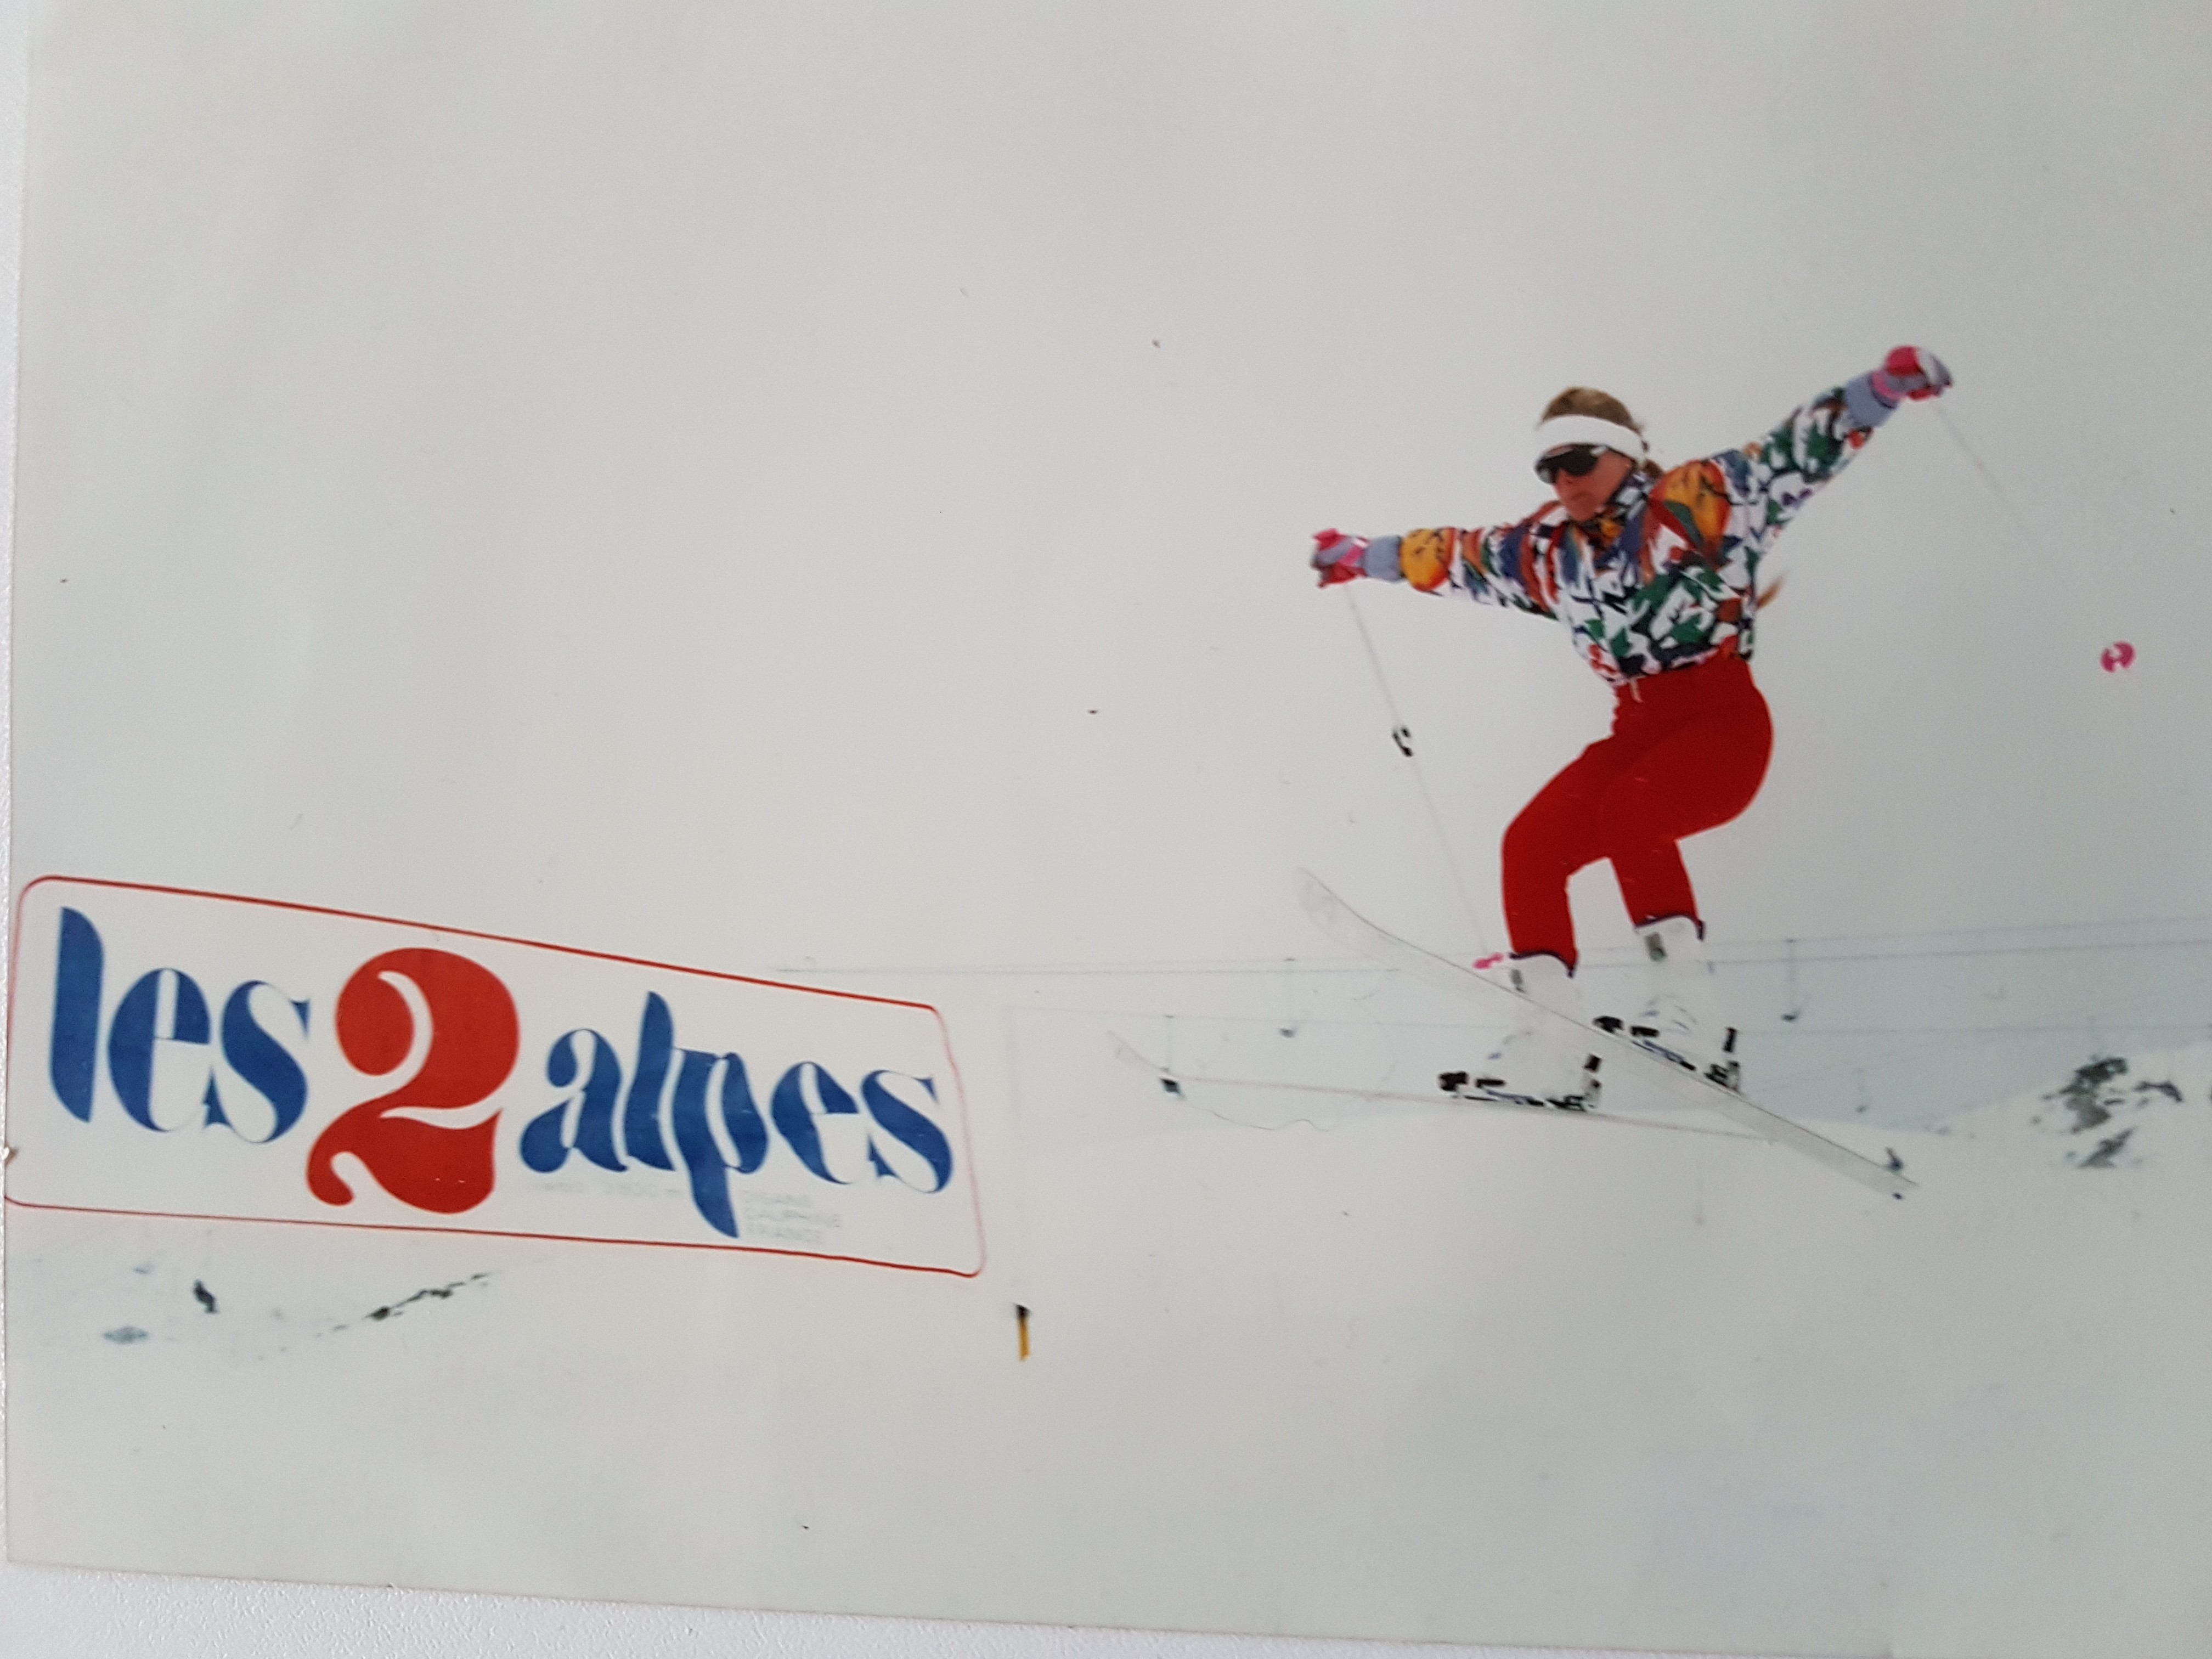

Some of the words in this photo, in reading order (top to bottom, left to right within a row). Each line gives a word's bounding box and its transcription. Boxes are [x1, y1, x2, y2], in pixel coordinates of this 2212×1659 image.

[49, 907, 310, 1143] les
[306, 947, 520, 1215] 2
[518, 991, 953, 1238] alpes
